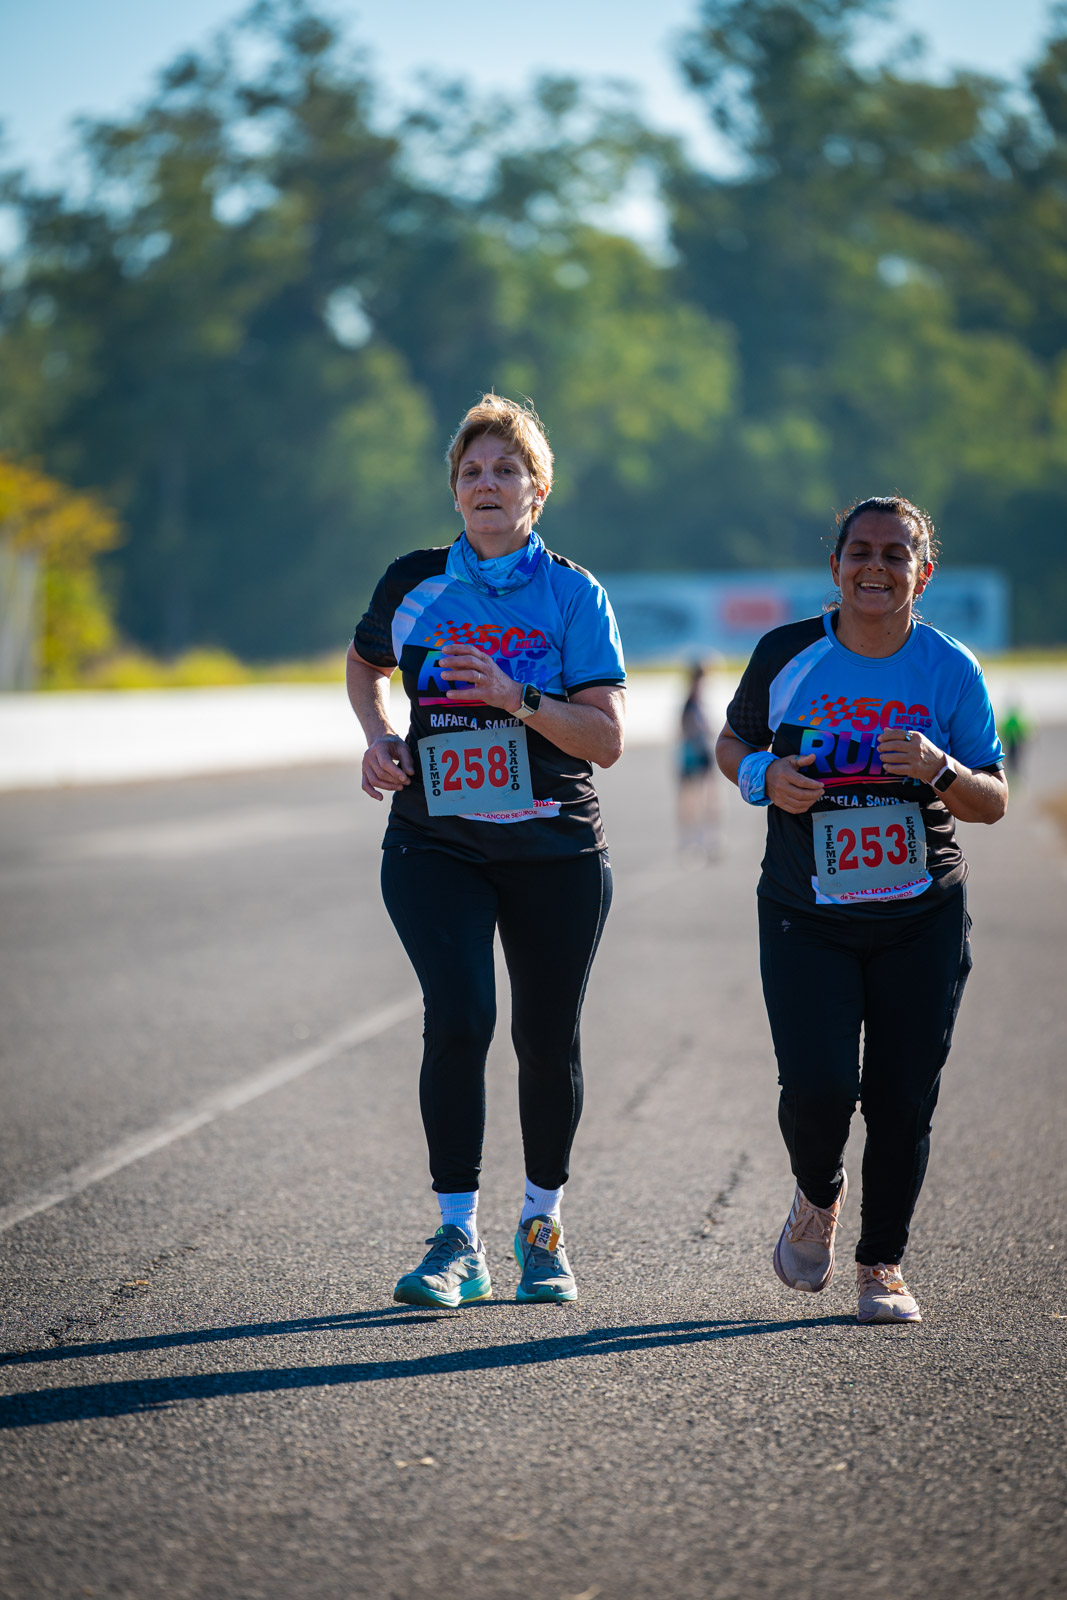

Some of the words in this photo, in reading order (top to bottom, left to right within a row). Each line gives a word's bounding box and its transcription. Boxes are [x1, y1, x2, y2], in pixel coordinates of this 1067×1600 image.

[895, 714, 933, 728] MILLAS
[427, 746, 441, 797] TIEMPO
[441, 745, 509, 791] 258
[508, 740, 520, 791] EXACTO
[824, 825, 837, 875] TIEMPO
[836, 823, 908, 871] 253
[905, 816, 917, 864] EXACTO
[538, 1226, 552, 1245] 258
